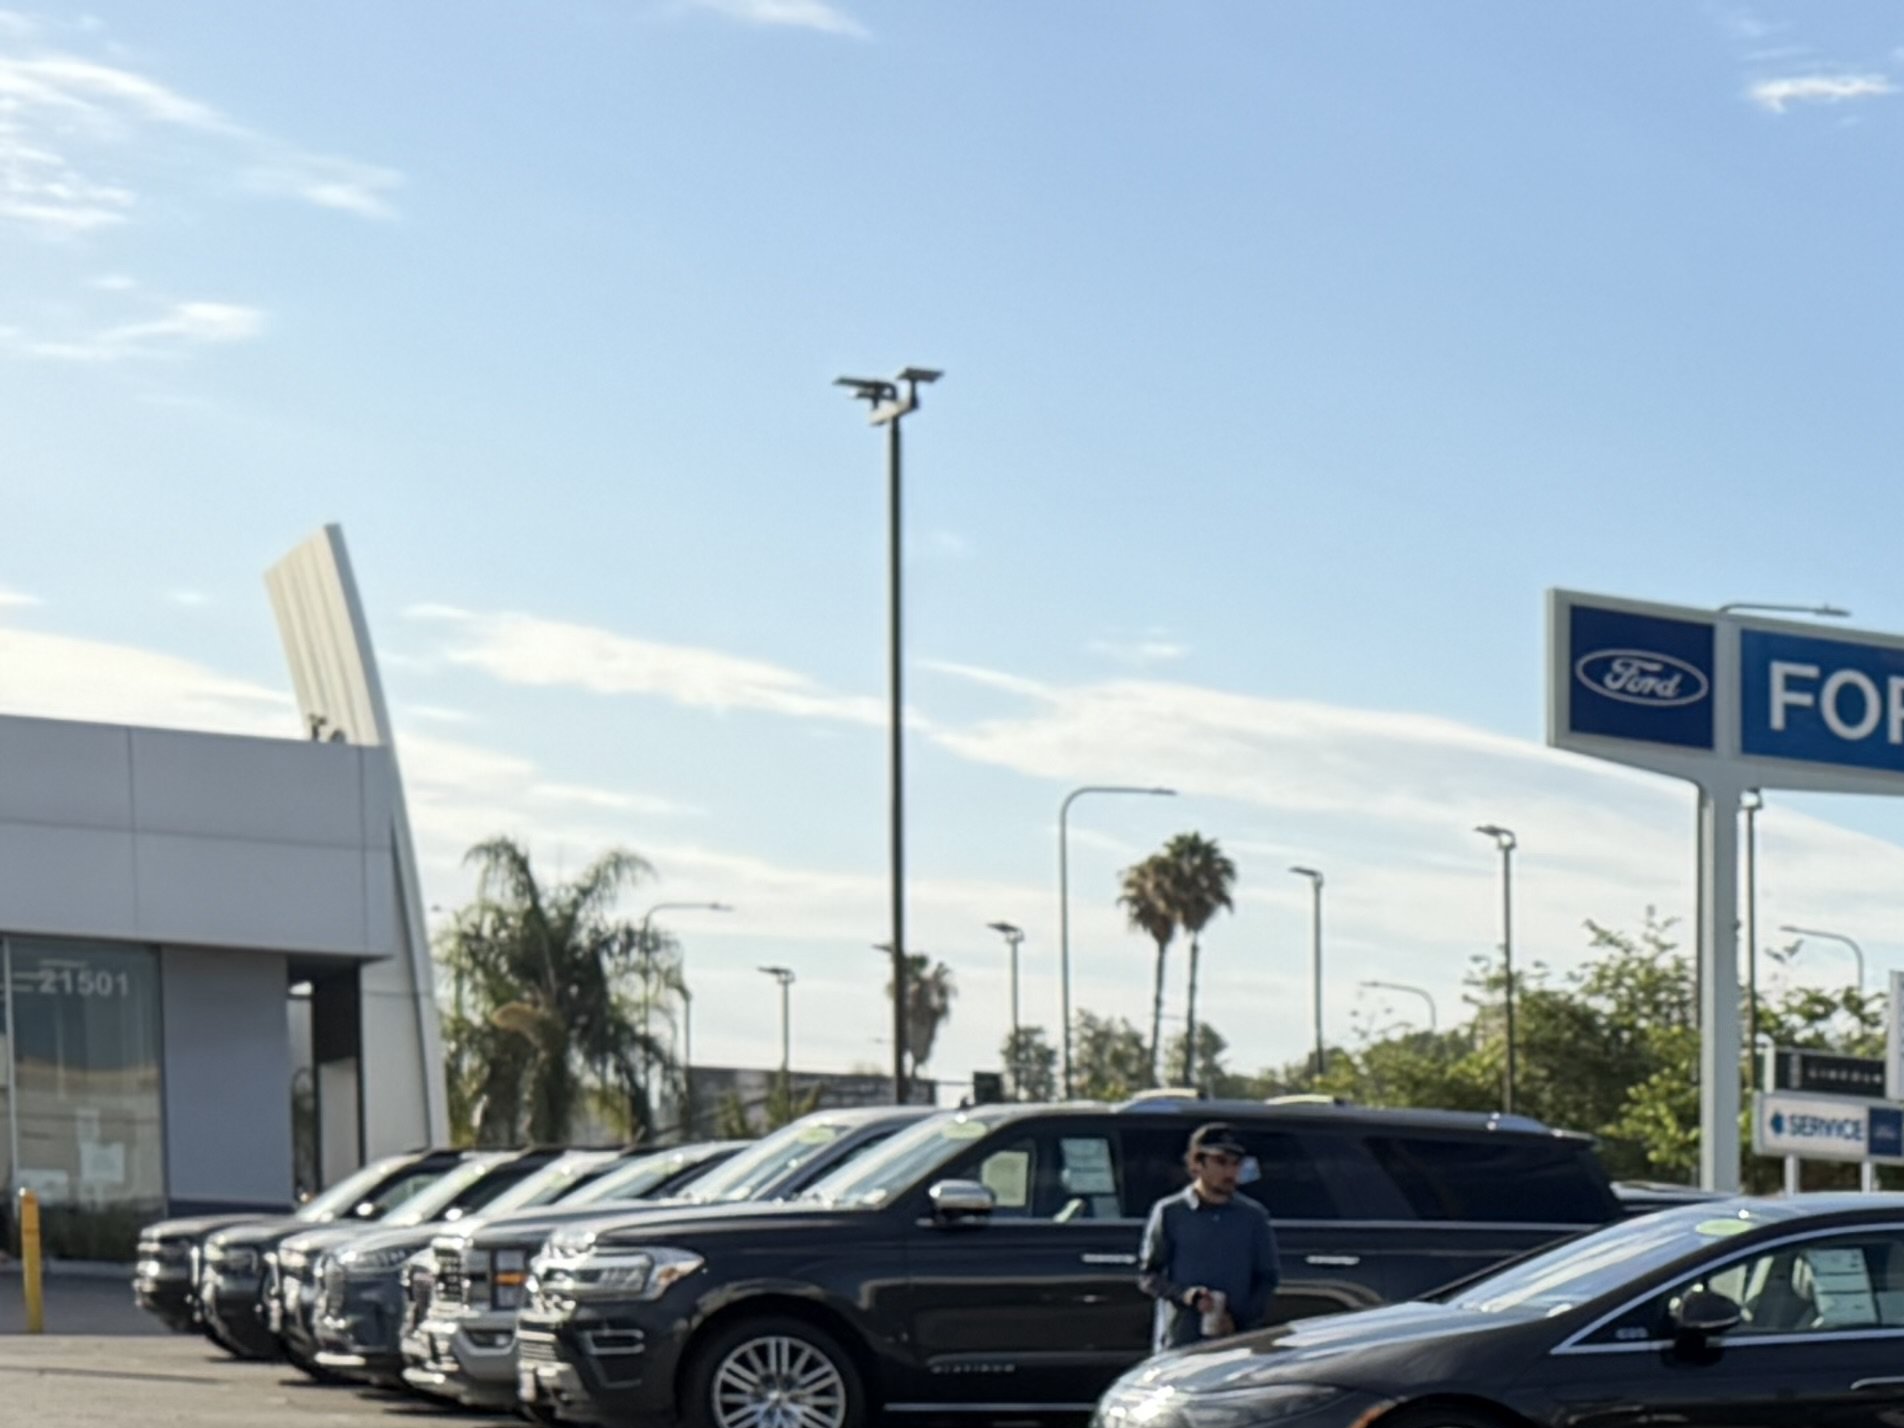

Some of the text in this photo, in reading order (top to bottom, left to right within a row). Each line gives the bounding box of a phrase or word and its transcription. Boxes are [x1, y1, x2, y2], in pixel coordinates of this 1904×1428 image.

[1603, 658, 1683, 697] Ford
[40, 969, 129, 998] 21501
[1788, 1114, 1864, 1141] SERVICE
